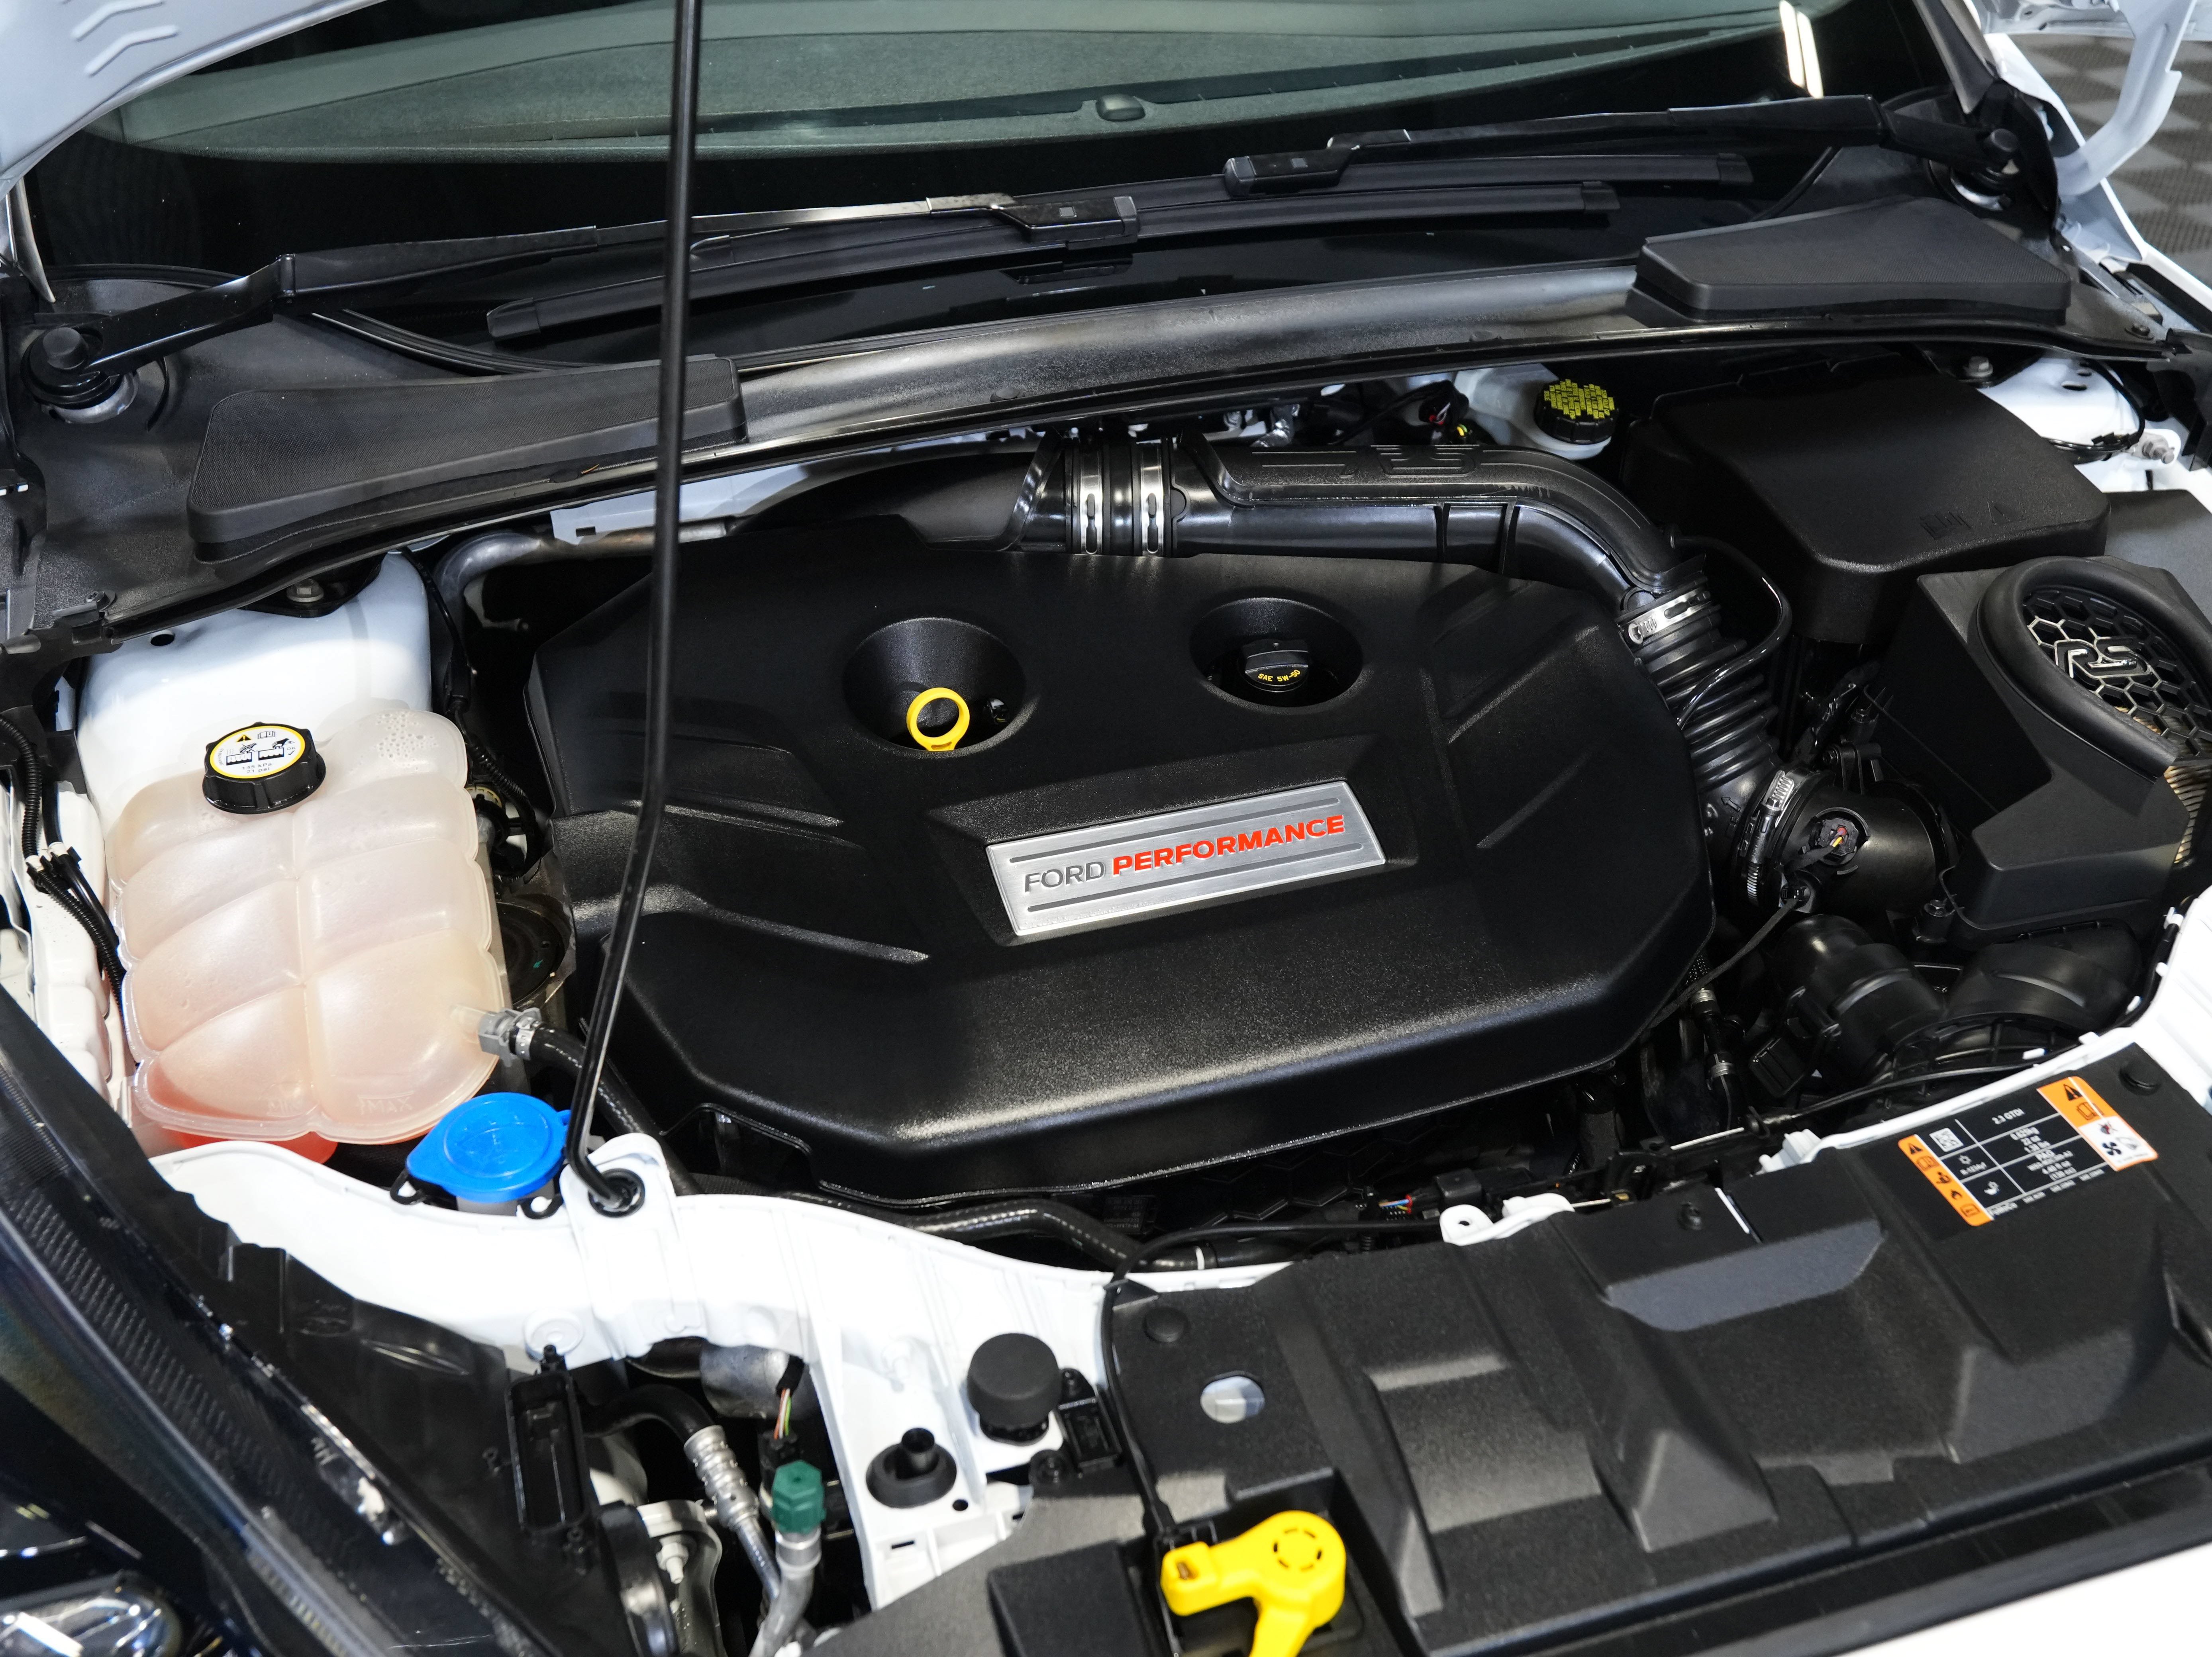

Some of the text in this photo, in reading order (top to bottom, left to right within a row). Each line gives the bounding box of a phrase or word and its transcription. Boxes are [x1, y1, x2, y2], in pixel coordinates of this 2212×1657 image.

[1258, 669, 1301, 682] SAE 5W-50
[1024, 814, 1346, 893] FORD PERFORMANCE
[366, 1097, 413, 1113] MAX
[1992, 1108, 2025, 1124] 2.3 GTDI
